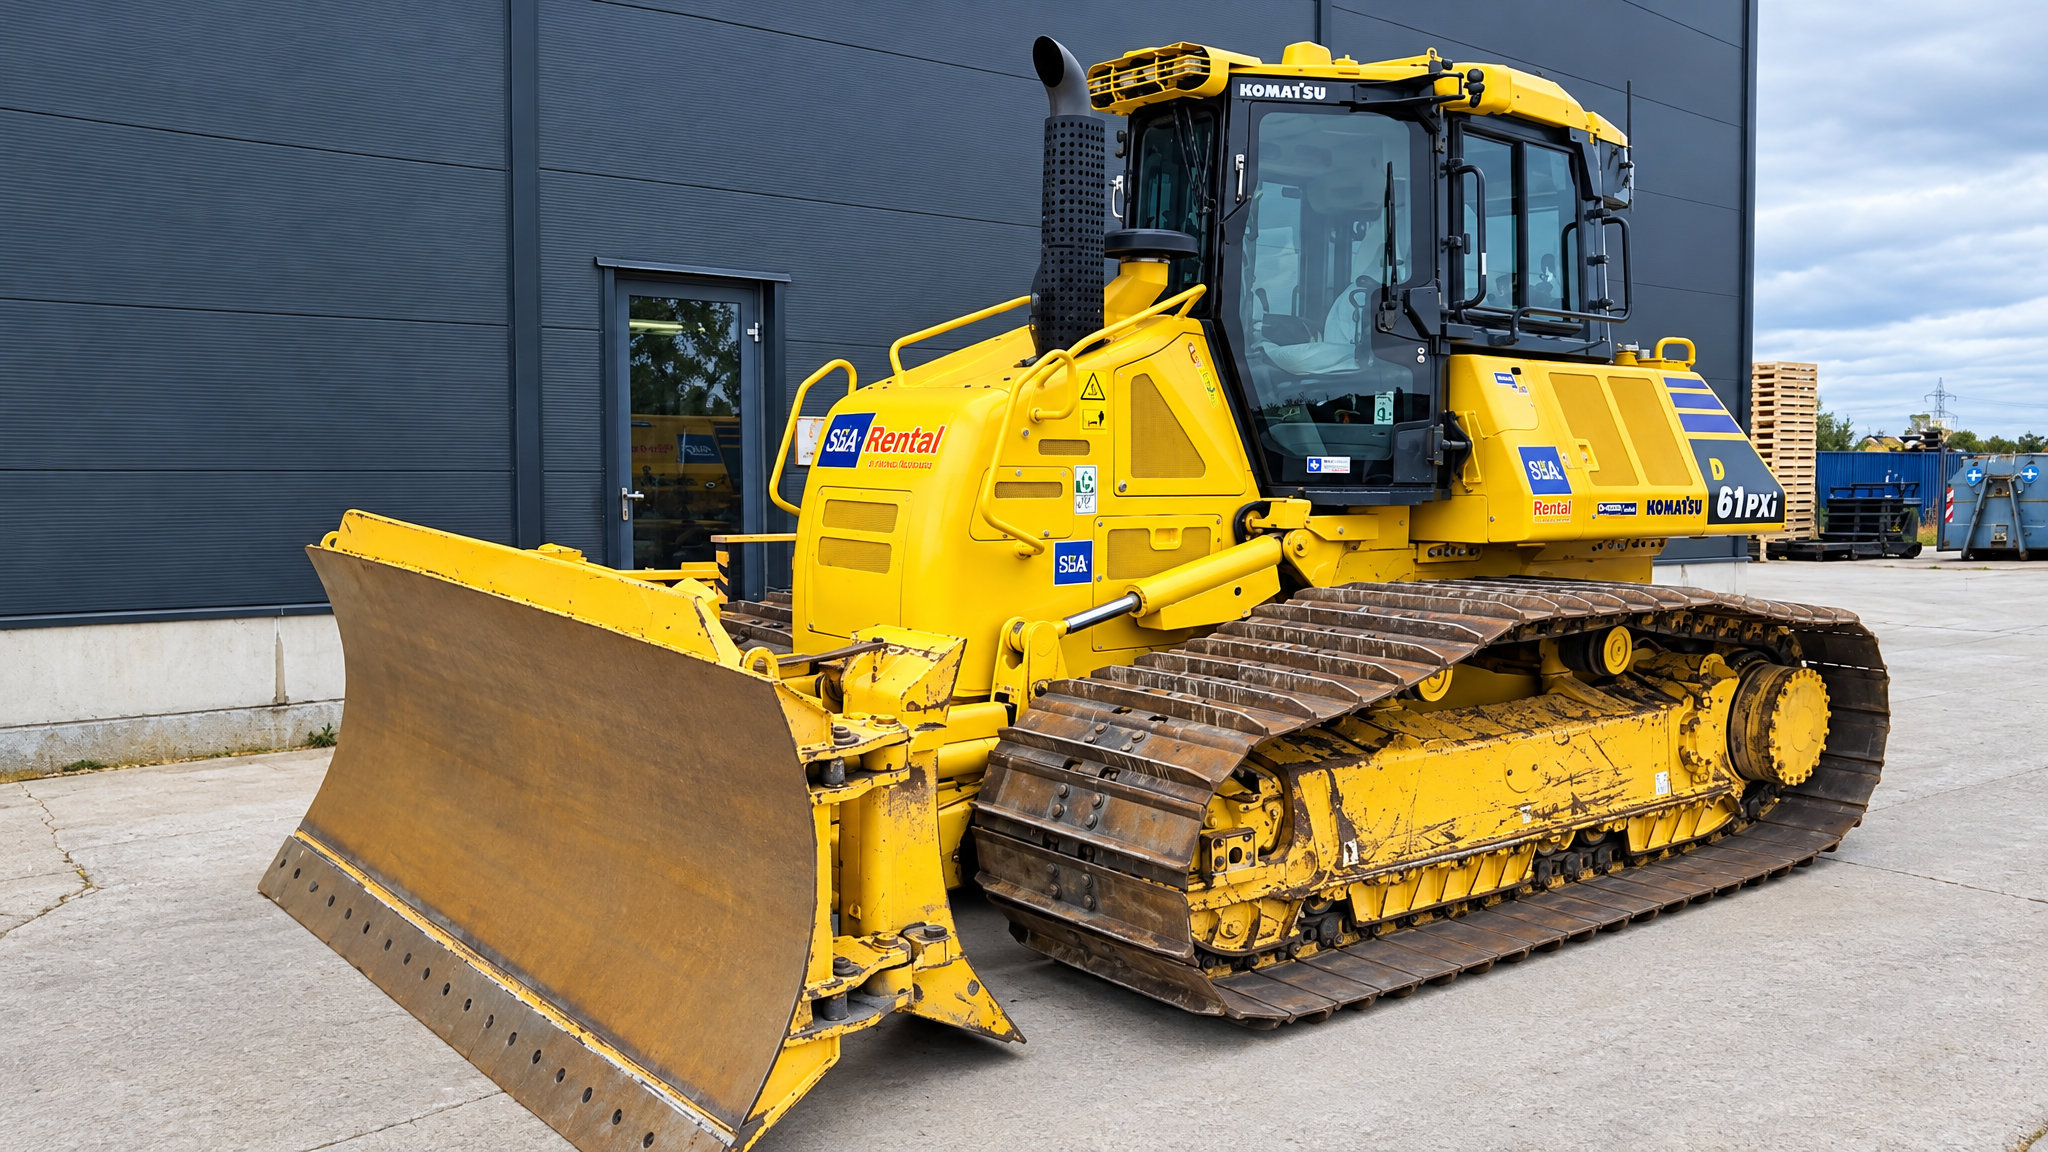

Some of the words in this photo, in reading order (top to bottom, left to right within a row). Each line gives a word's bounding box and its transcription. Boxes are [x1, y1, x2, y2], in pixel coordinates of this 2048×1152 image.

[1239, 83, 1326, 100] KOMATSU
[863, 425, 945, 455] Rental
[1708, 457, 1725, 481] D
[1533, 499, 1572, 516] Rental
[1646, 496, 1703, 516] KOMATSU
[1717, 485, 1777, 519] 61PXi
